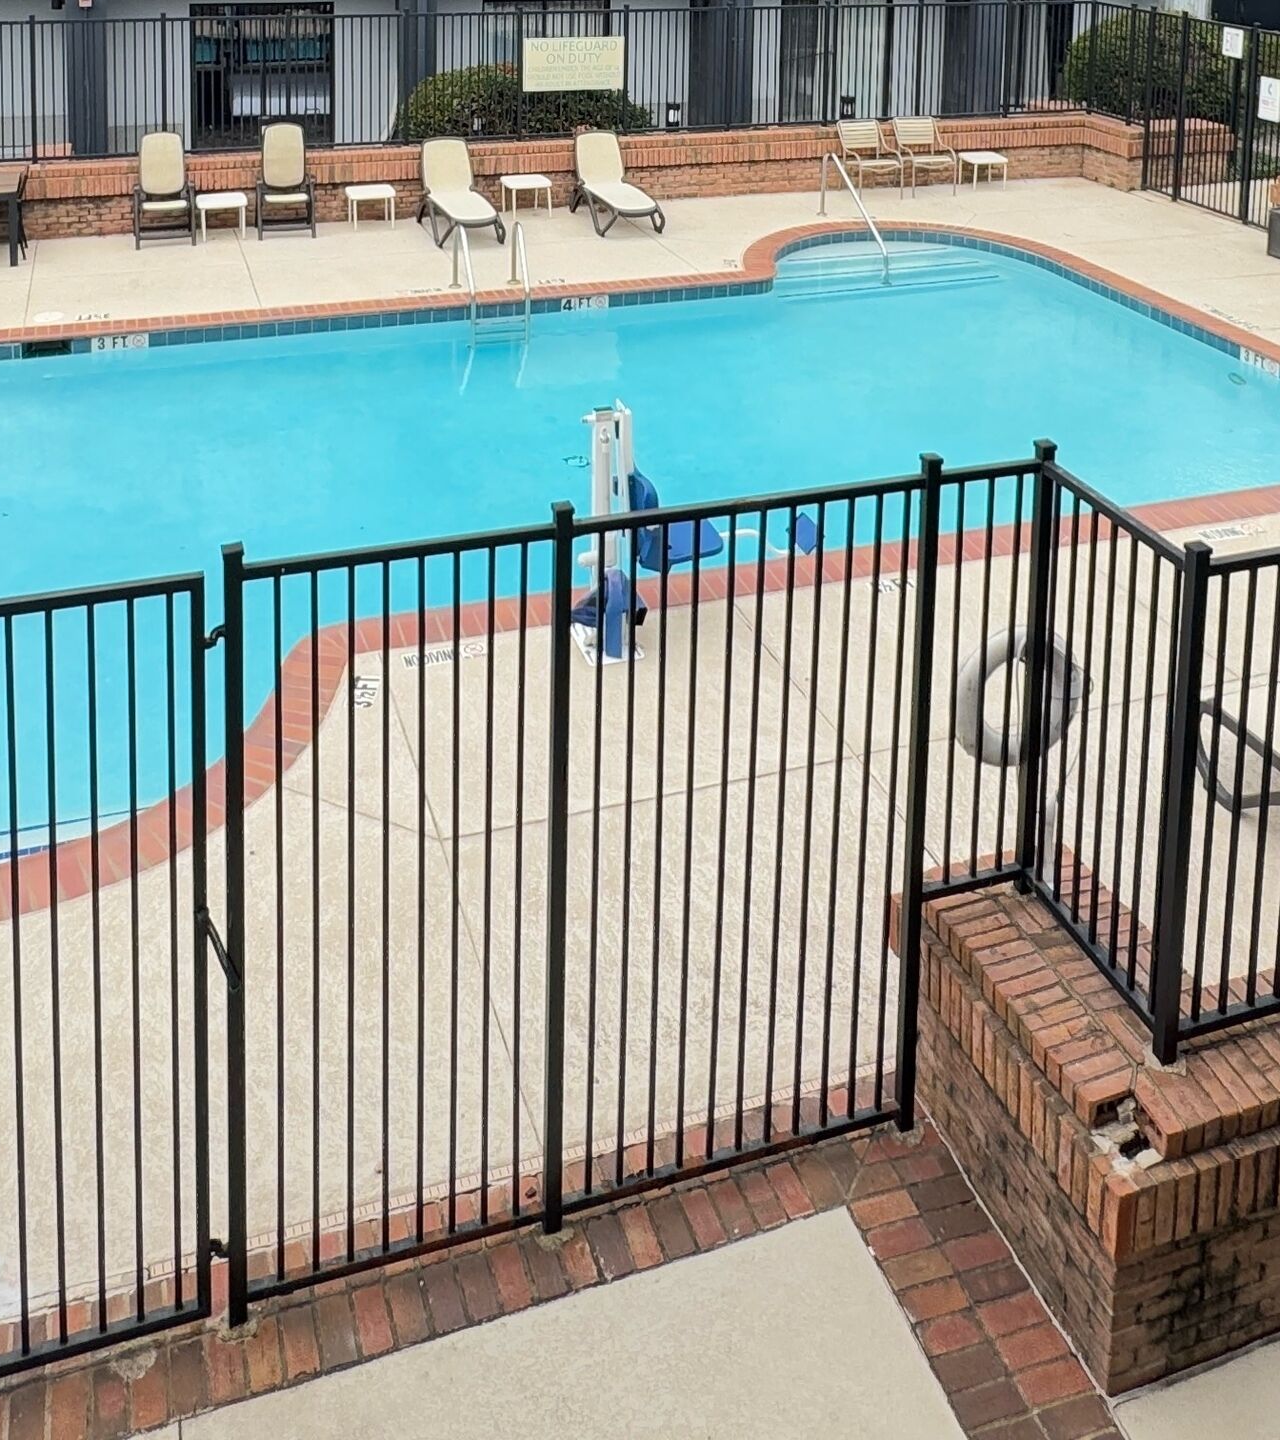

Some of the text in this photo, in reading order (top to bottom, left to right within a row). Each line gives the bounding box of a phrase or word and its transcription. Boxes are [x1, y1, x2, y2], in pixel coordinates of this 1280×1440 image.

[531, 41, 618, 52] NO LIFEGUARD
[546, 52, 602, 64] ON DUTY
[403, 654, 421, 668] NO
